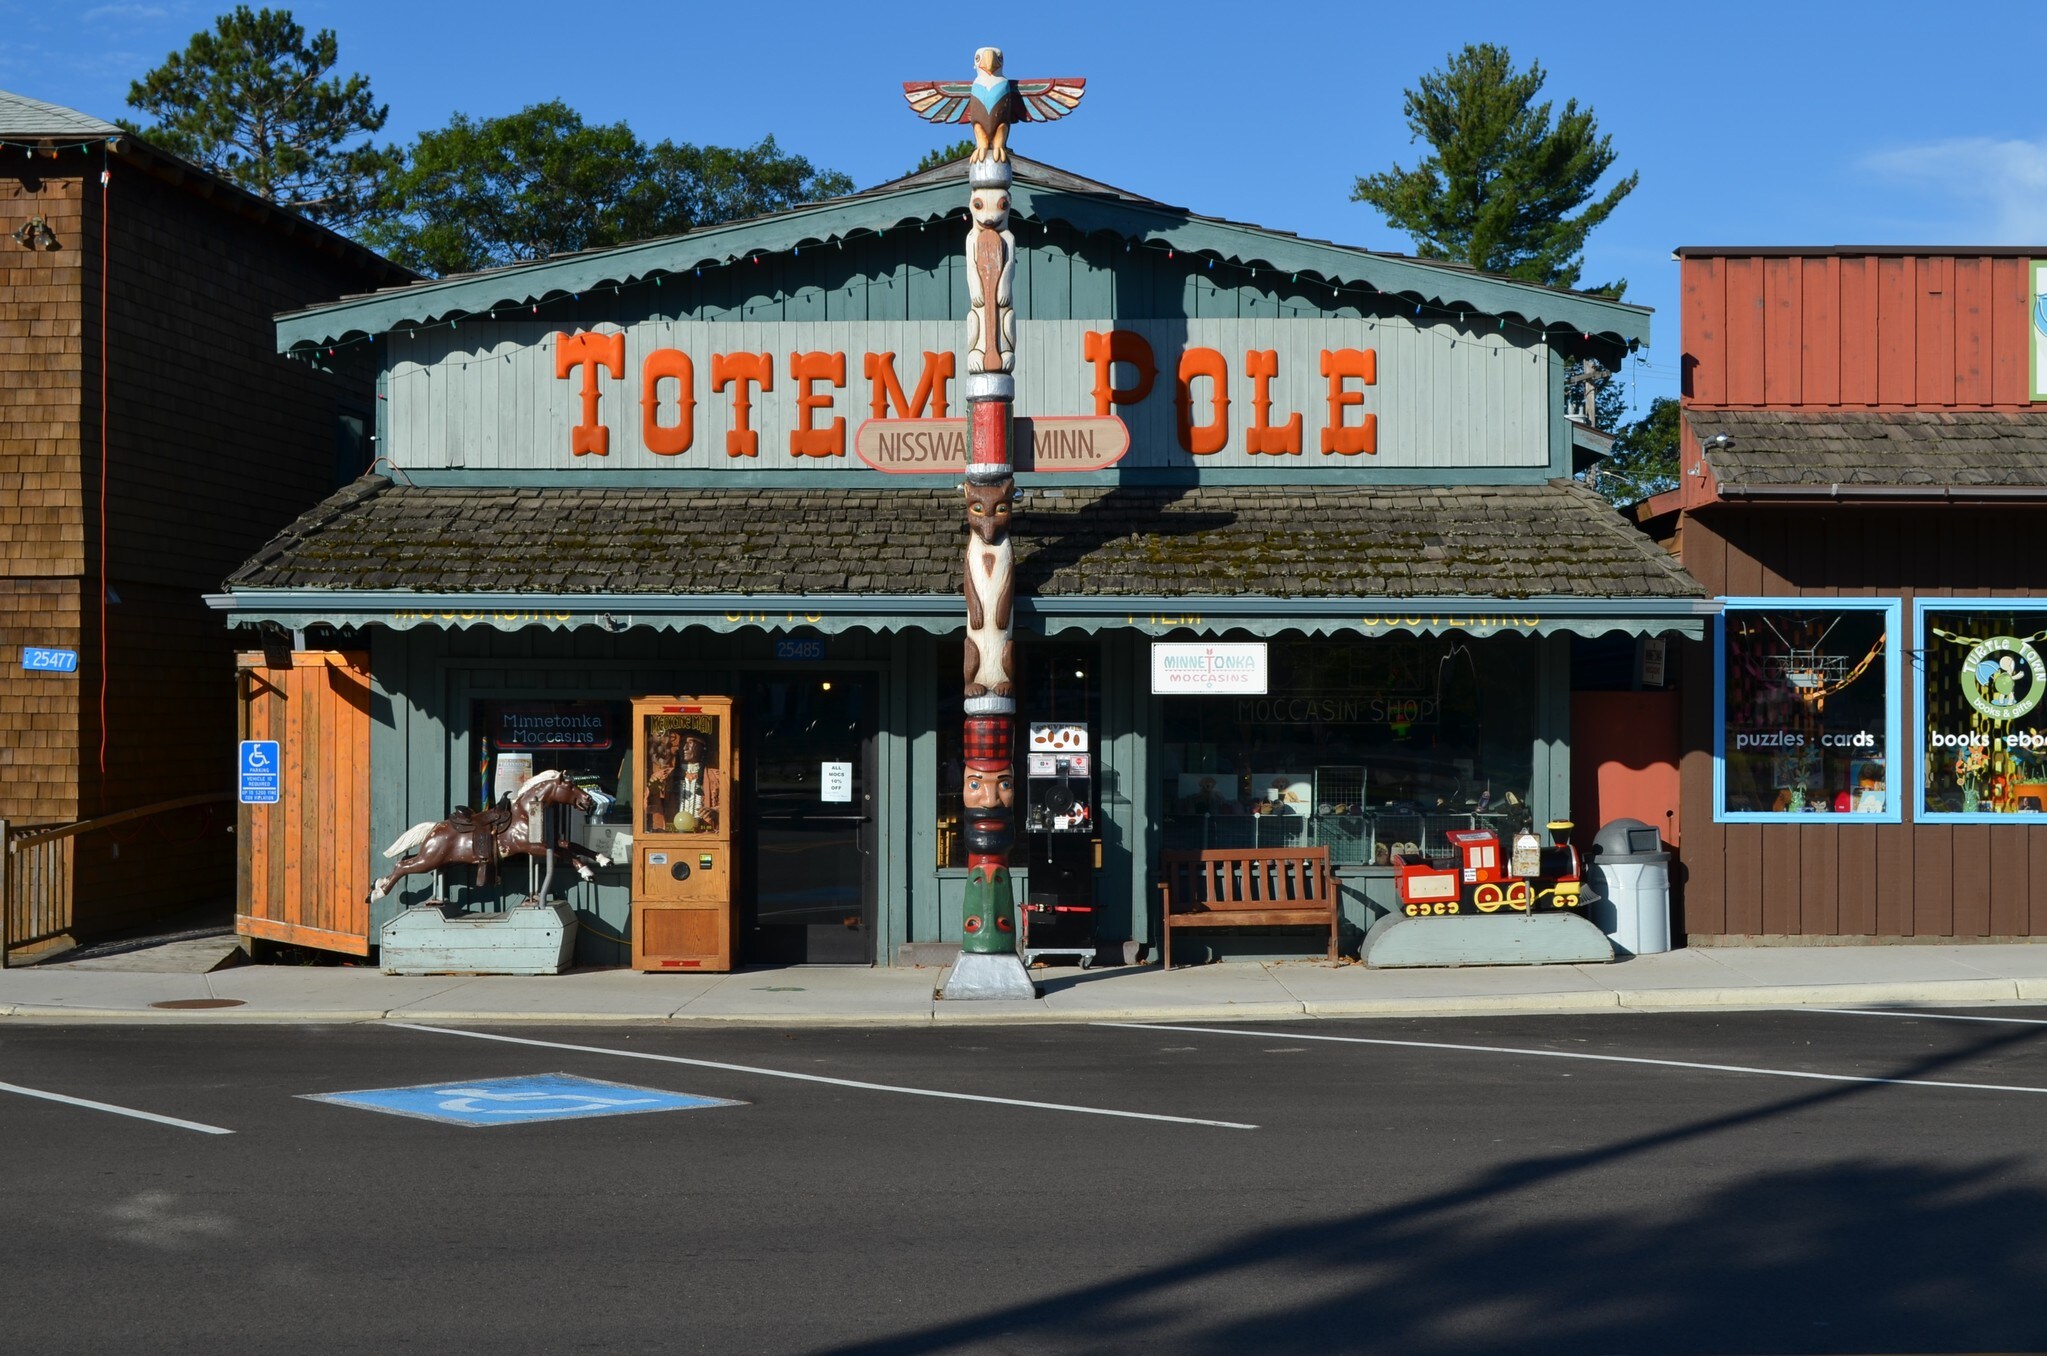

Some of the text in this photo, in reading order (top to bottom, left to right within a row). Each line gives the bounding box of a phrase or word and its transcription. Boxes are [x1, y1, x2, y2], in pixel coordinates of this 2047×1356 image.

[556, 330, 1378, 457] TOTEM POLE
[878, 429, 1102, 461] NISSWA MINN.
[777, 641, 820, 657] 25485
[32, 650, 75, 669] 25477
[1164, 653, 1256, 672] MINNETONKA
[1963, 639, 2047, 682] TURTLE TOWN
[1169, 673, 1249, 683] MOCCASINS
[1238, 699, 1434, 721] MOCCASIN SHOP
[1973, 697, 2033, 718] books & gifts
[503, 714, 603, 728] Minnetonka
[512, 729, 594, 743] Moccasins
[1736, 730, 1875, 750] puzzles cards
[1931, 730, 1990, 747] books
